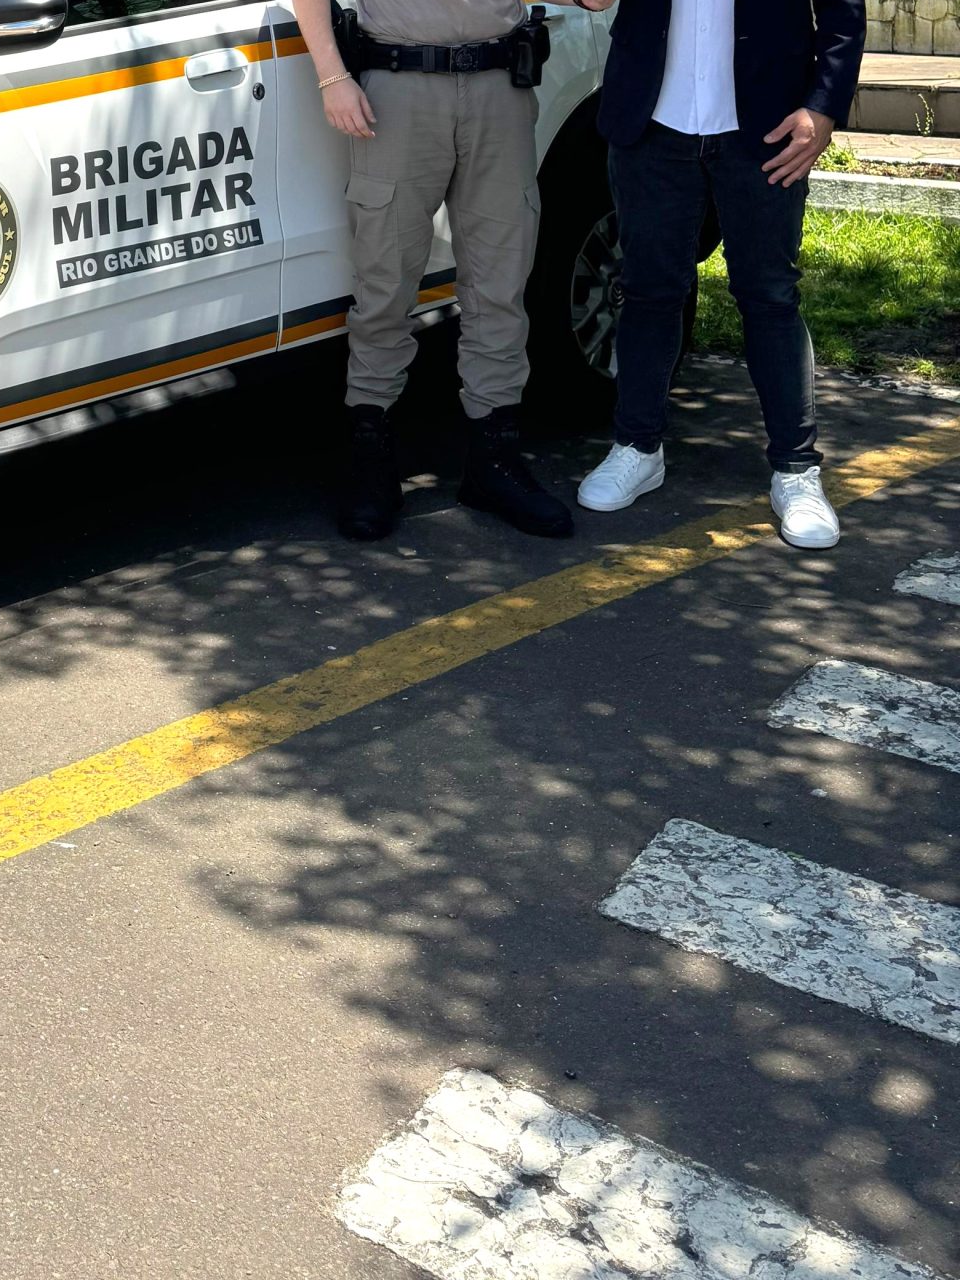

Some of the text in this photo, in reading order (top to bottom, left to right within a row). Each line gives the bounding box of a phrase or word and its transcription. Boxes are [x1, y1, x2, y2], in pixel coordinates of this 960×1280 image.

[50, 126, 254, 196] BRIGADA
[52, 172, 256, 245] MILITAR
[61, 224, 260, 282] RIO GRANDE DO SUL
